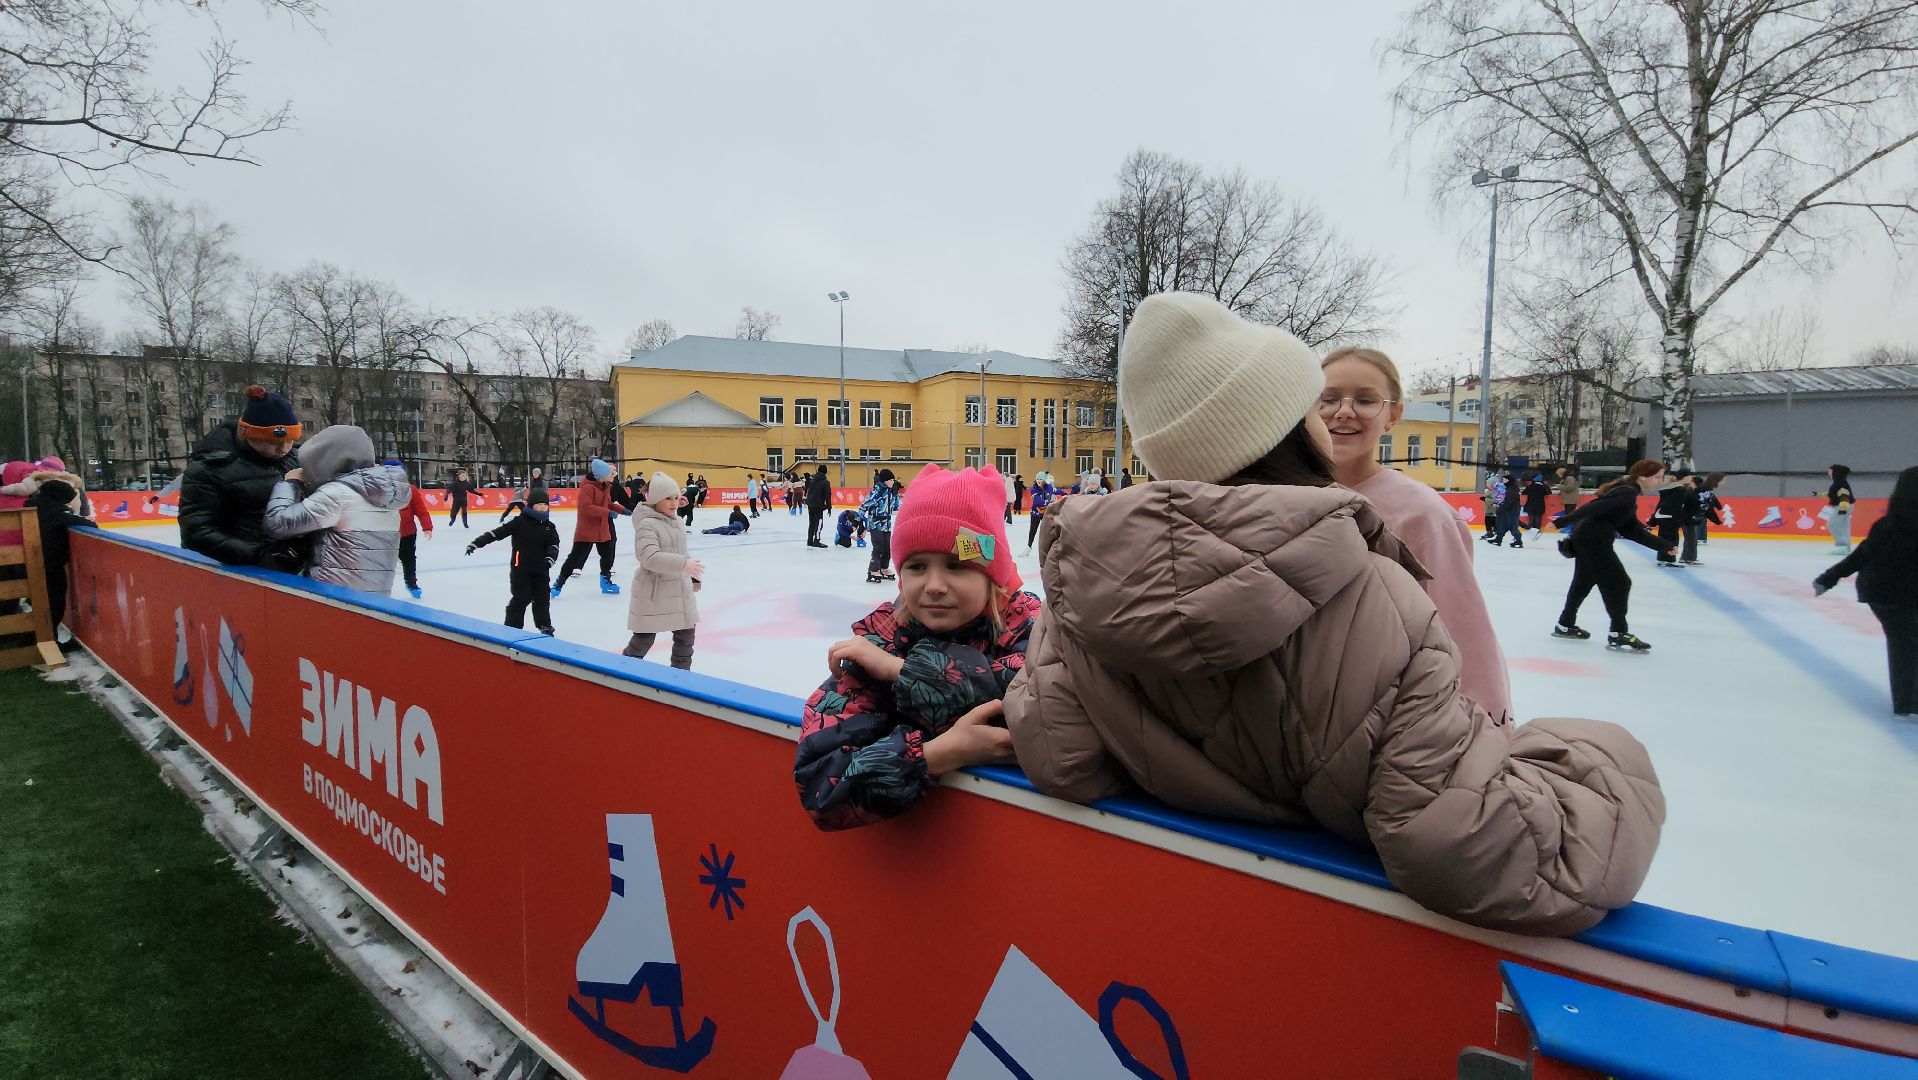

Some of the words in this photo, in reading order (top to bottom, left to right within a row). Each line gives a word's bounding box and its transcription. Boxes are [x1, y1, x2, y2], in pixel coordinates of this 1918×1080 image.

[299, 657, 444, 826] ЗИМА
[303, 763, 313, 794] В
[315, 771, 447, 896] ПОДМОСКОВЬЕ
